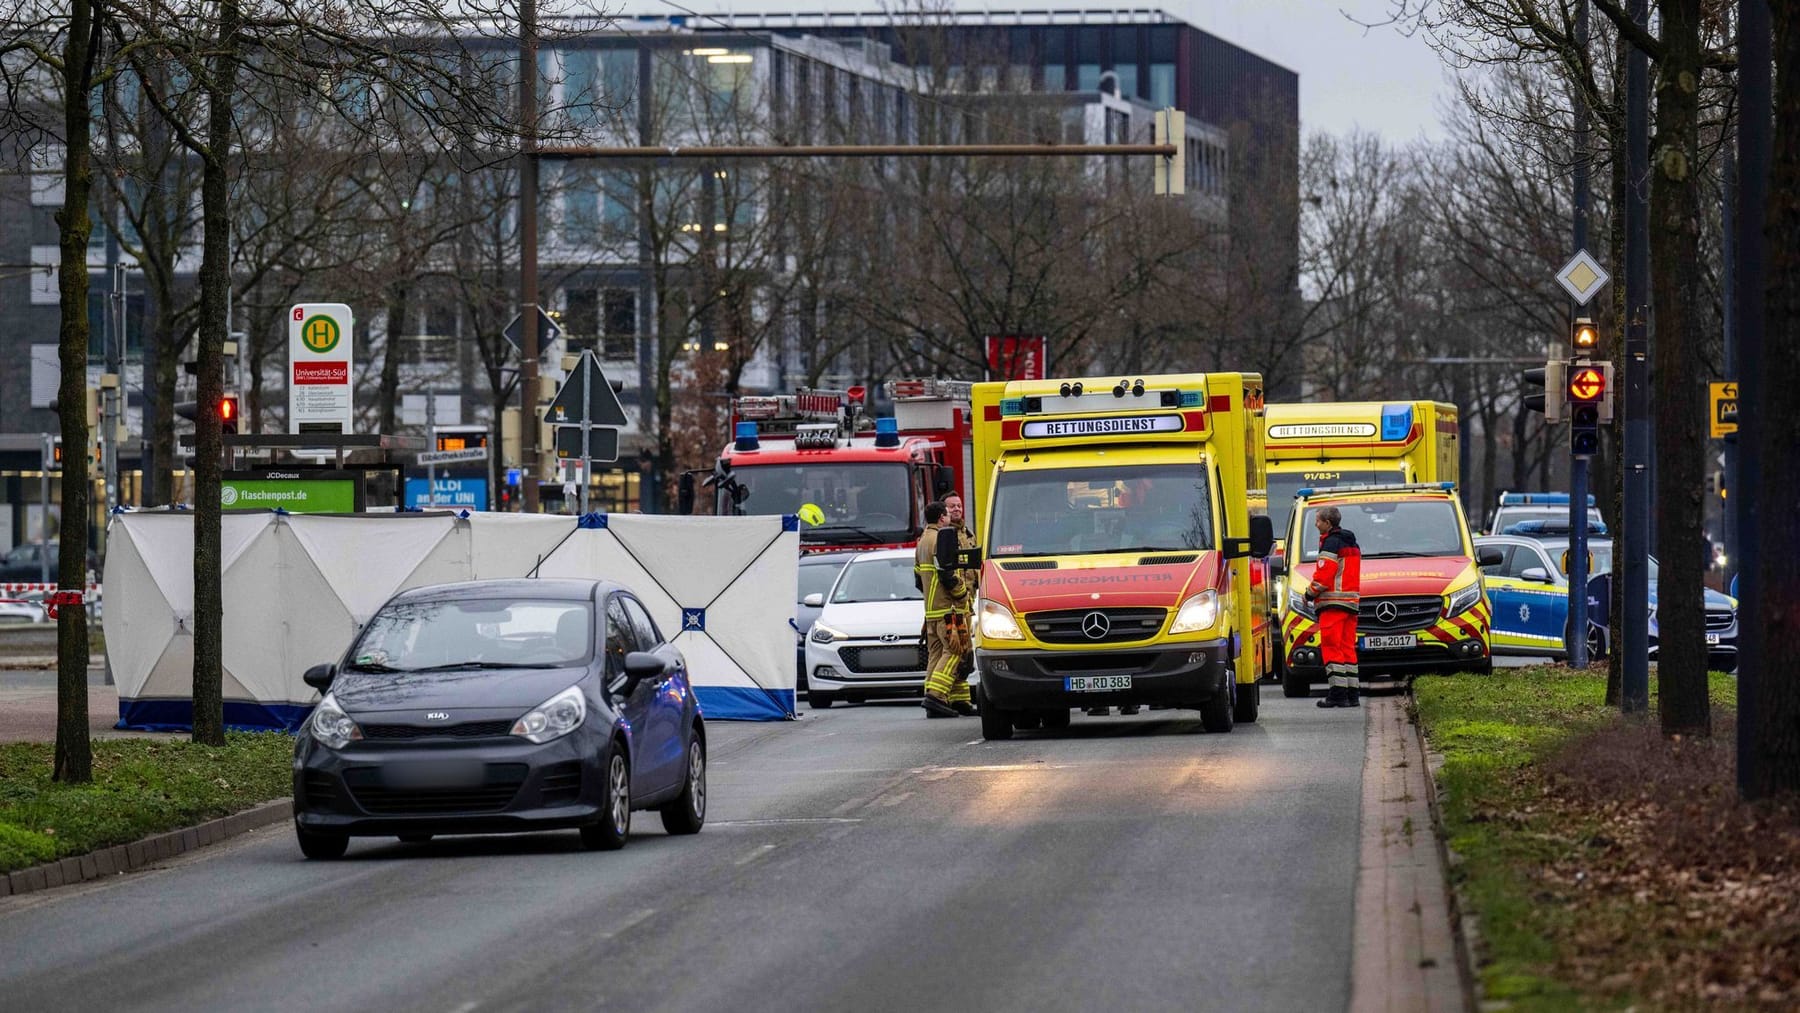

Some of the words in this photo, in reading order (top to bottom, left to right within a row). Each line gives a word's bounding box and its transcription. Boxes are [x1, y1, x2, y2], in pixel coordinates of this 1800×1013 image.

[313, 323, 329, 345] H
[1046, 418, 1156, 435] RETTUNGSDIENST
[1279, 426, 1366, 435] RETTUNGSDIENST
[1303, 472, 1341, 481] 91/83-1
[241, 490, 307, 501] flaschenpost.de
[417, 494, 430, 503] an
[455, 493, 475, 503] UNI
[1369, 638, 1382, 647] HB
[1388, 636, 1411, 647] 2017
[1071, 678, 1086, 689] HB
[1092, 677, 1108, 689] RD
[1109, 676, 1131, 688] 383
[427, 712, 445, 720] KIA
